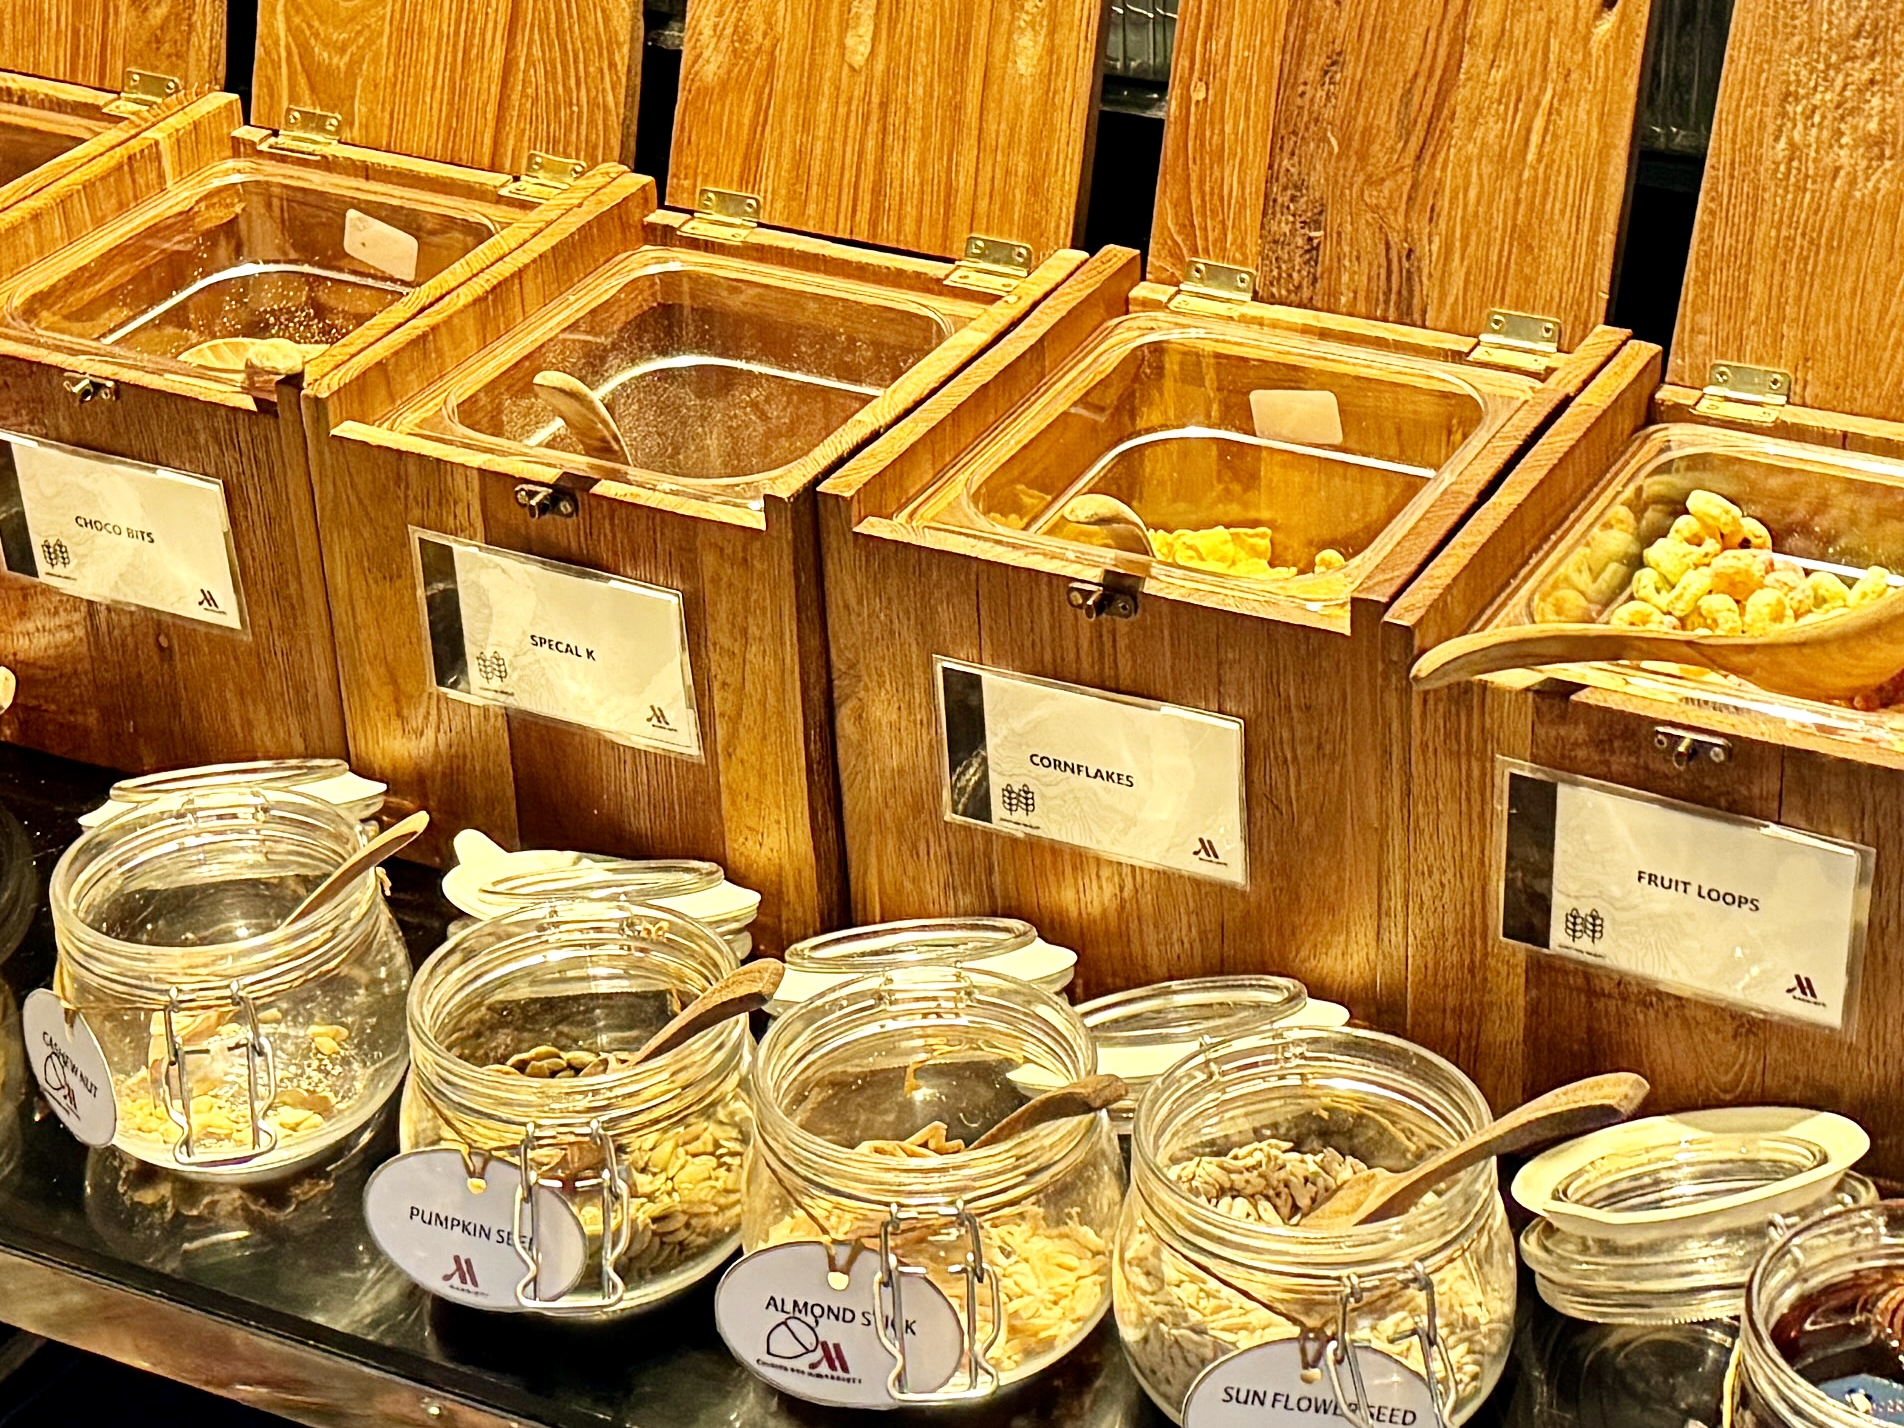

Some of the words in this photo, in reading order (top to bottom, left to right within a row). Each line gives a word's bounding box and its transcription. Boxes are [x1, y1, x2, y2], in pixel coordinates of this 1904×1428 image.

[75, 515, 122, 536] CHOCO
[126, 527, 155, 544] BITS
[530, 634, 582, 658] SPECAL
[585, 647, 597, 661] K
[1029, 753, 1135, 788] CORNFLAKES
[1637, 869, 1692, 895] FRUIT
[1696, 884, 1760, 912] LOOPS
[409, 1205, 492, 1242] PUMPKIN
[765, 1295, 856, 1324] ALMOND
[1222, 1385, 1267, 1407] SUN
